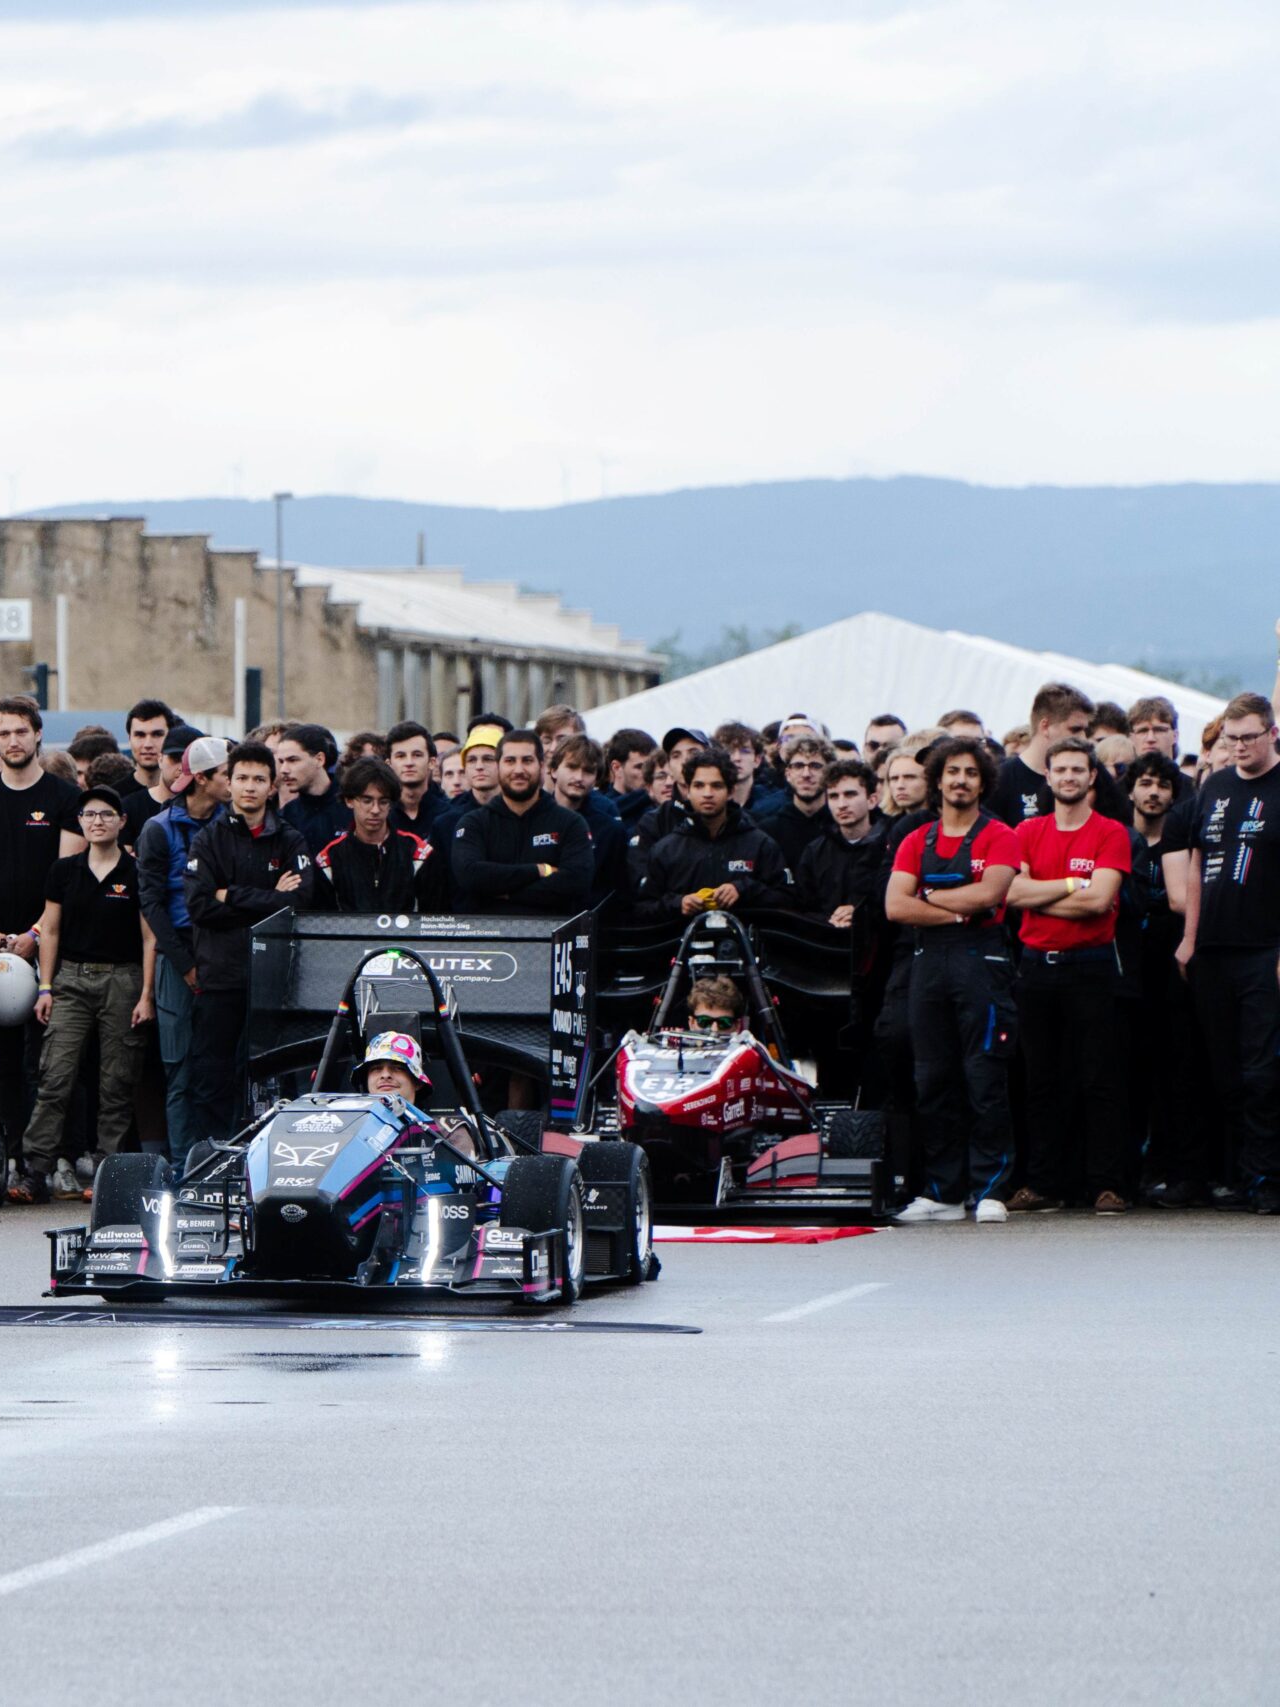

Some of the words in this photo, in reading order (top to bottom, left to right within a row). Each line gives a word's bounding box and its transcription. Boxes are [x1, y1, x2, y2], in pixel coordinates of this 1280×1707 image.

[554, 941, 573, 996] E45
[453, 974, 492, 983] Company
[640, 1078, 695, 1091] E12
[94, 1231, 144, 1240] Fullwood
